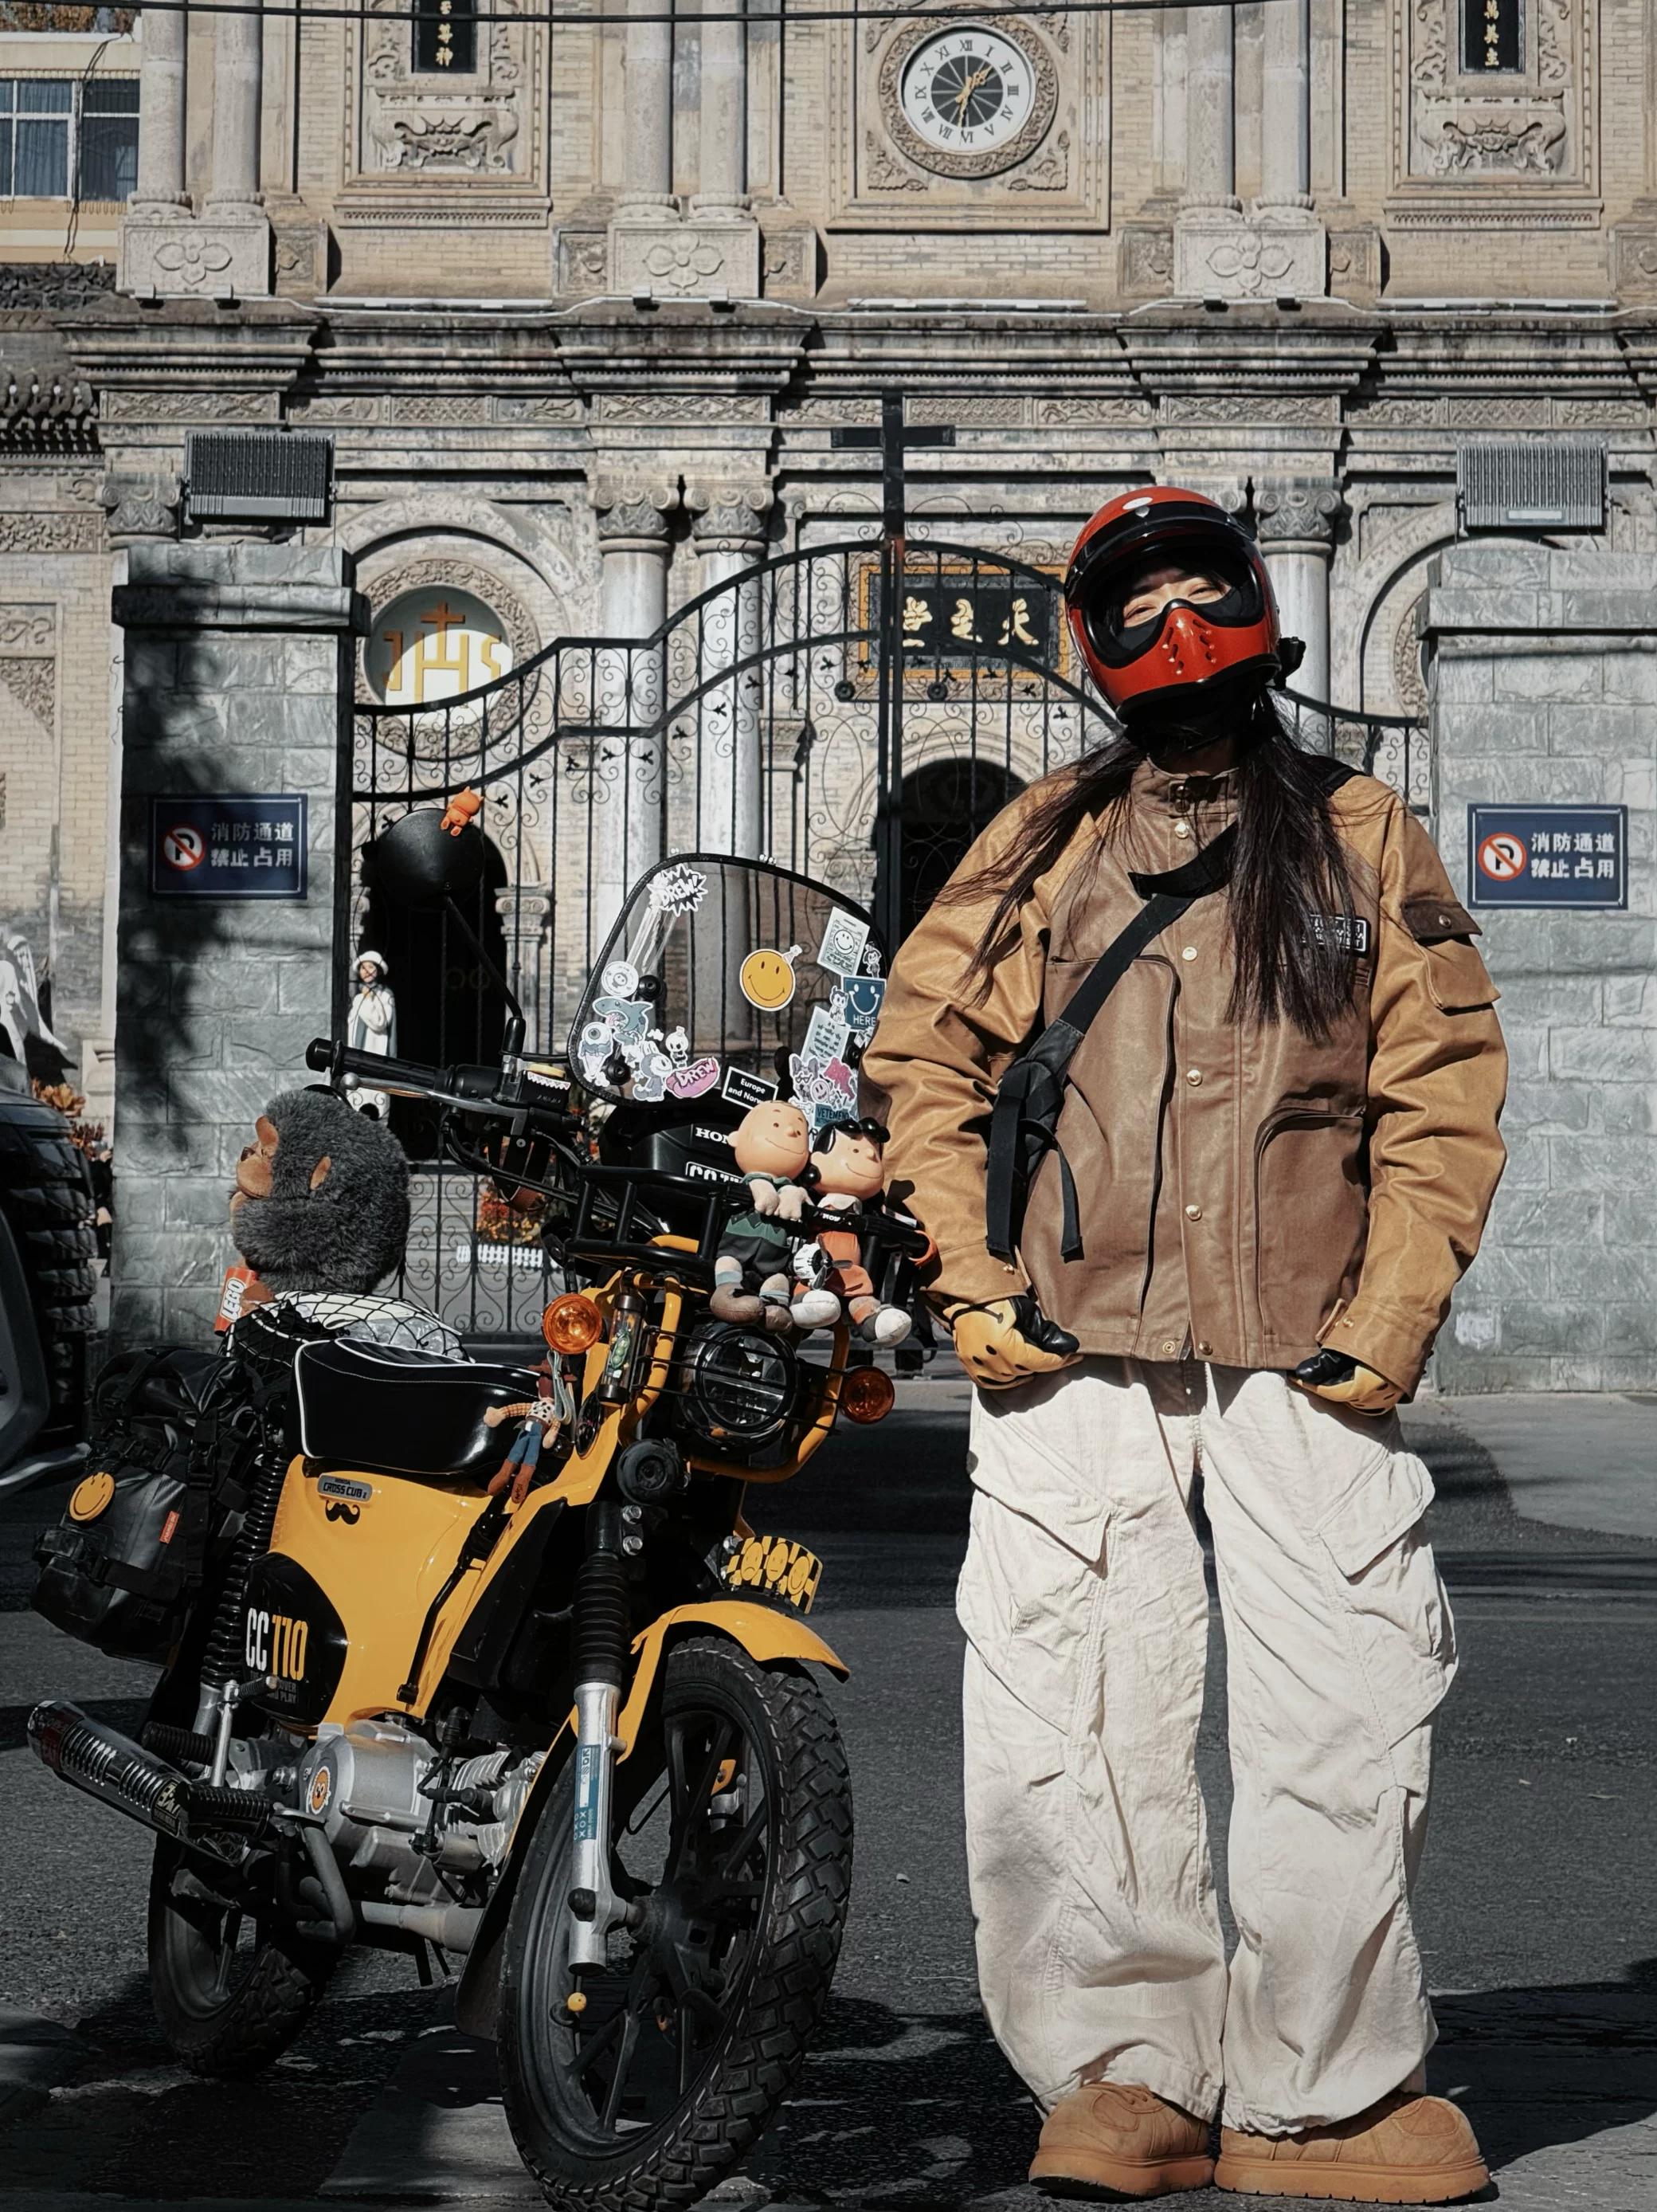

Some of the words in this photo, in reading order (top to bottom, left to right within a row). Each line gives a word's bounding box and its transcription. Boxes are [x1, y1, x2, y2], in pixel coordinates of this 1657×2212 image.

[210, 822, 294, 842] 消防通道
[1530, 831, 1616, 853] 消防通道
[210, 846, 294, 868] 禁止占用
[1530, 857, 1616, 880] 禁止占用
[659, 874, 699, 907] DREW!
[853, 1014, 876, 1027] HERE
[676, 1057, 715, 1087] DREW
[727, 1087, 743, 1097] and
[740, 1077, 766, 1094] Europe
[221, 1278, 245, 1322] LEGO
[323, 1481, 346, 1496] CROSS
[346, 1486, 363, 1499] CUB
